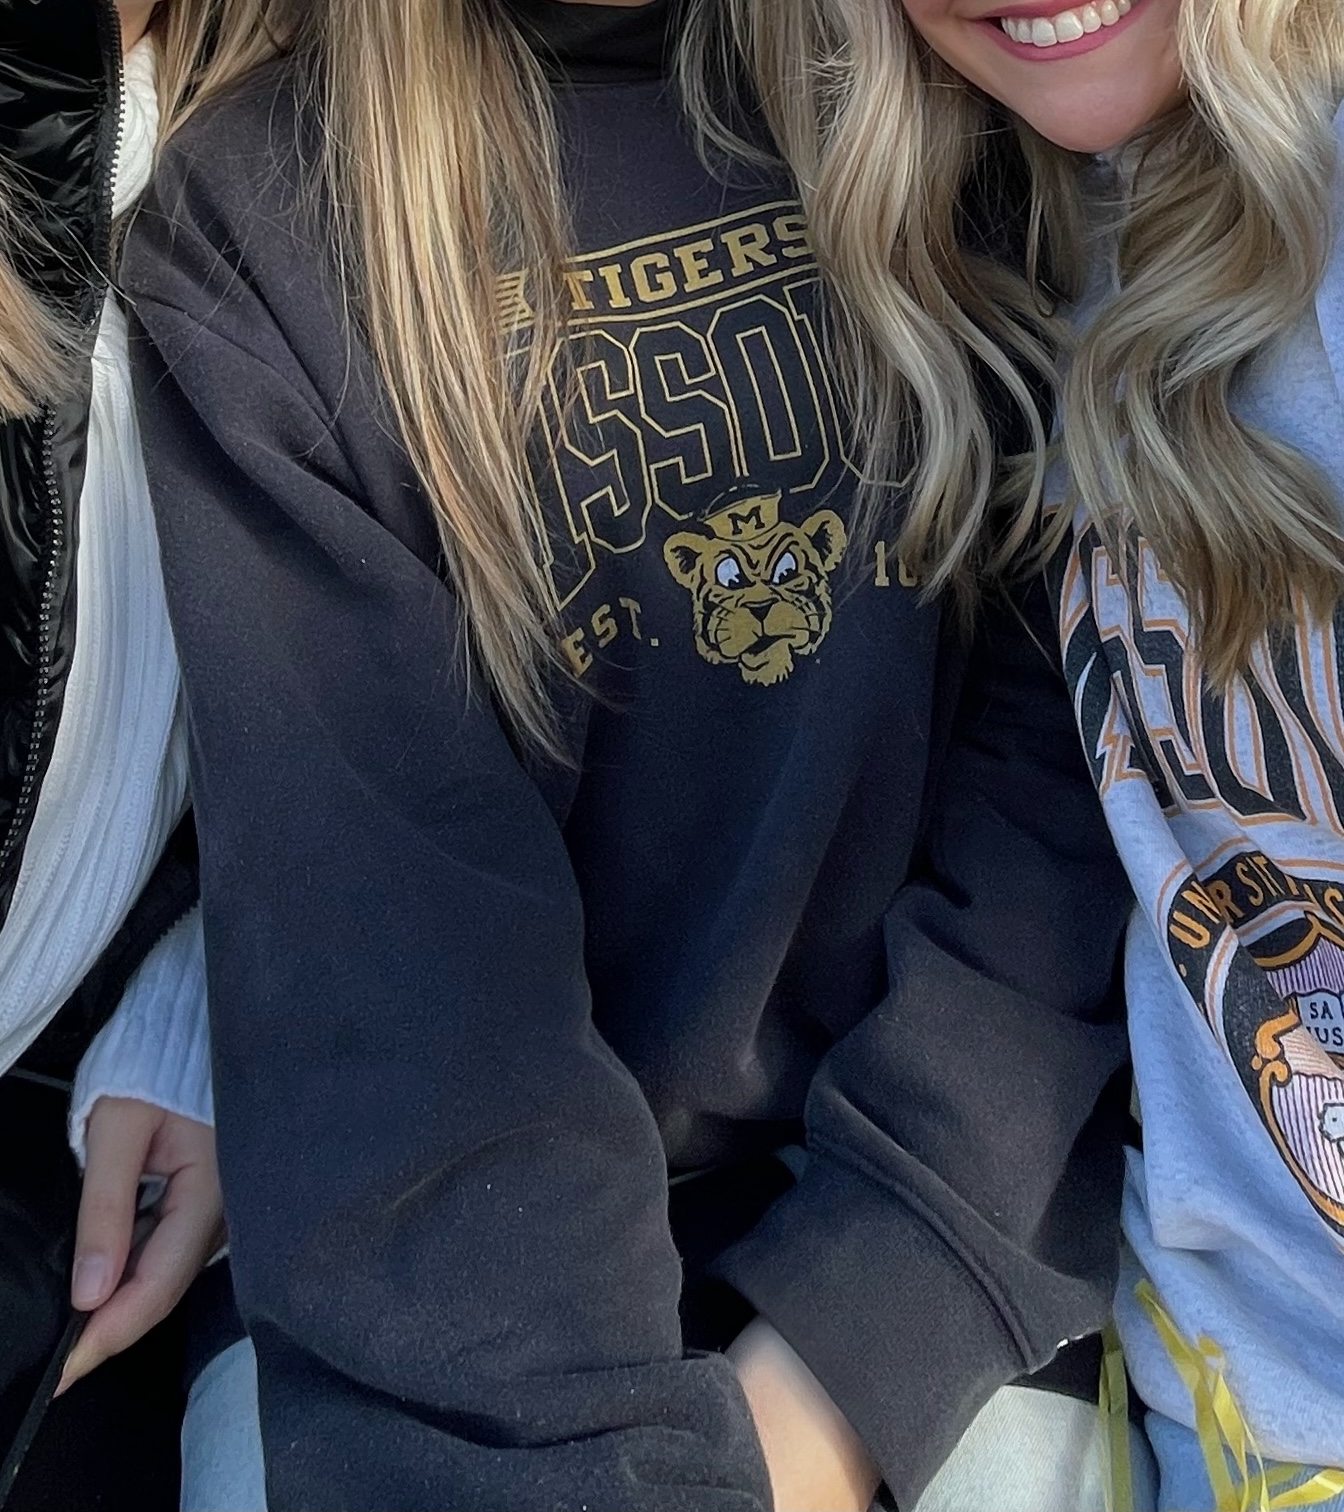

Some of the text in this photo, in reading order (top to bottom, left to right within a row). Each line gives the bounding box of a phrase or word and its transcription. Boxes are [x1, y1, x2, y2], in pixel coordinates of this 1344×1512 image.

[562, 213, 816, 311] TIGERS
[561, 595, 660, 678] EST.
[1306, 1026, 1344, 1046] US
